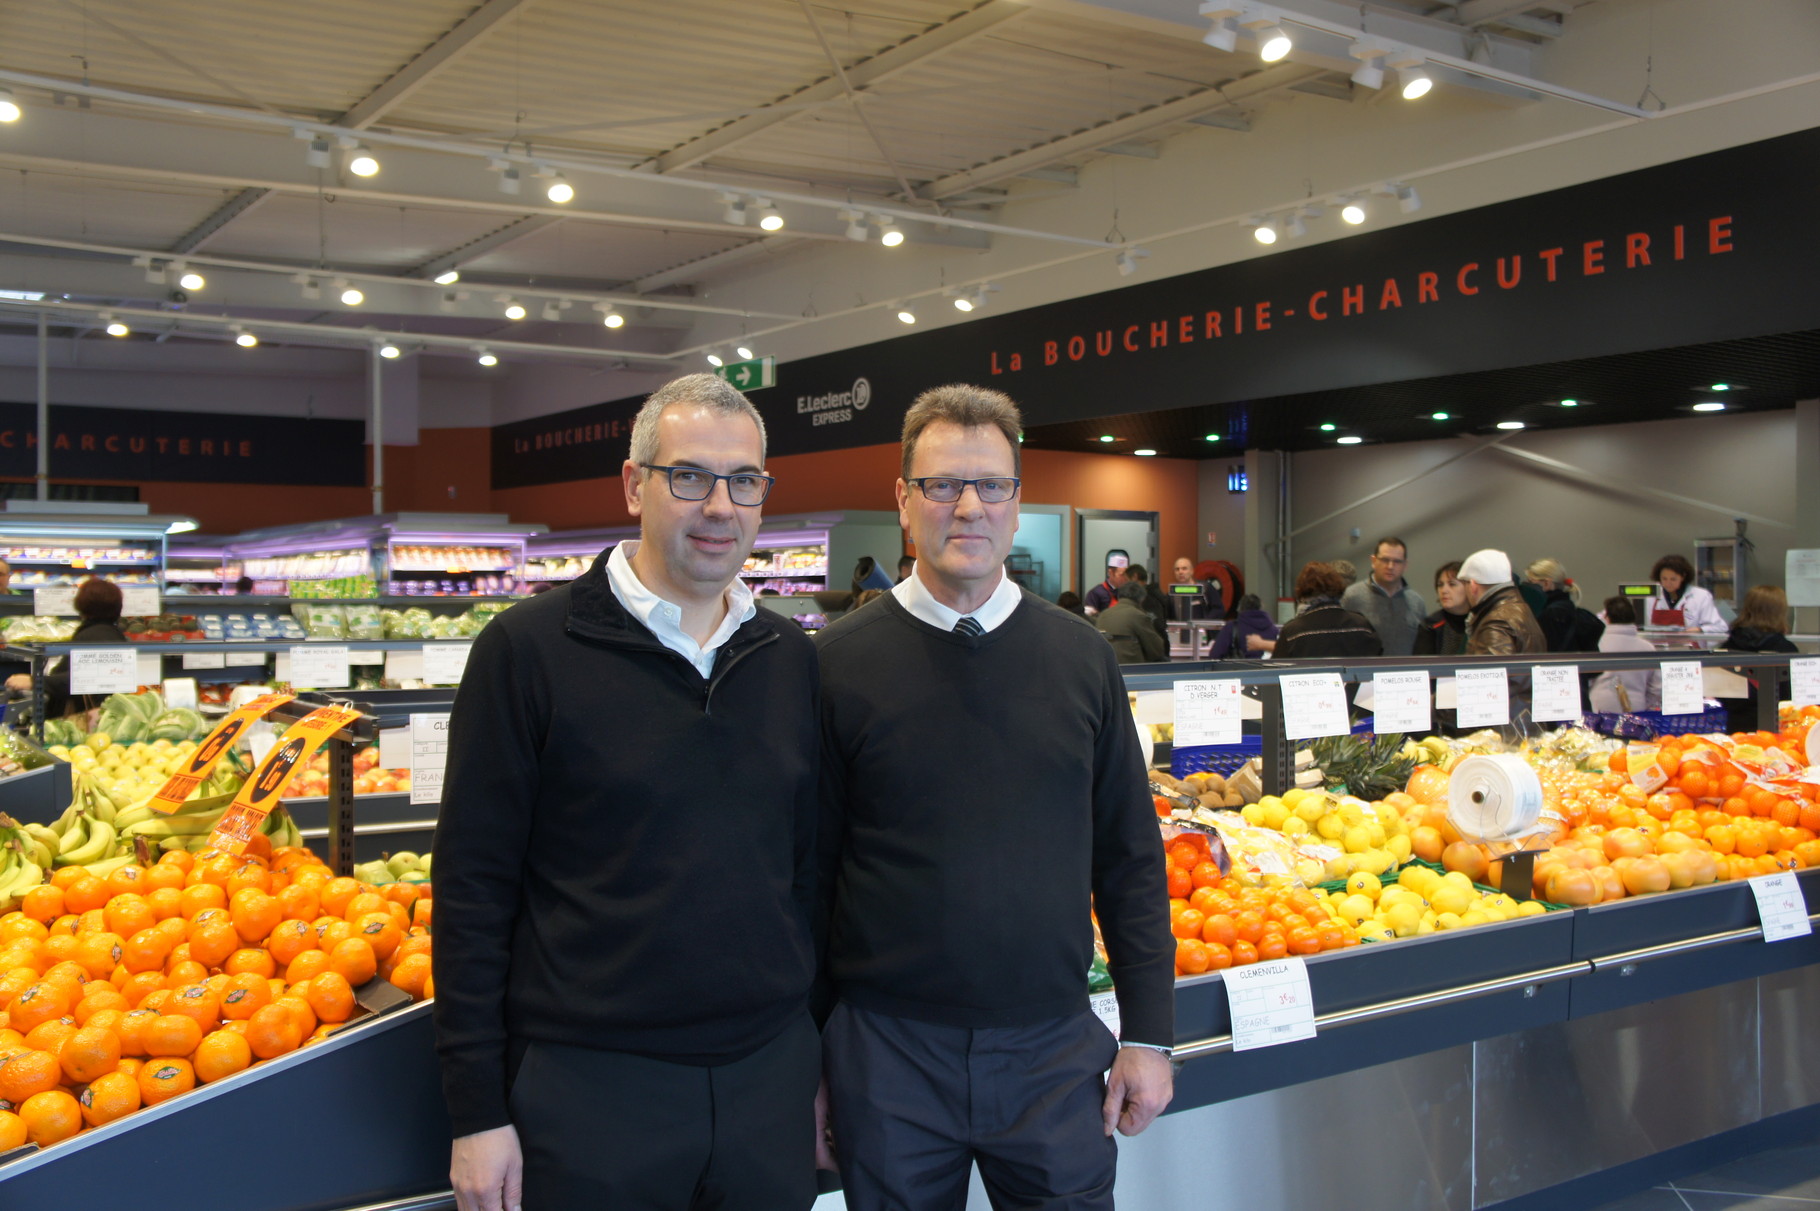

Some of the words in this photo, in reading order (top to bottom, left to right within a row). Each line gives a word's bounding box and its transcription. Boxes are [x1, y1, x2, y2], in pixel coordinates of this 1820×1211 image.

[991, 350, 1022, 375] La
[1044, 215, 1734, 367] BOUCHERIE-CHARCUTERIE
[797, 391, 852, 414] E.Leclerc
[812, 408, 852, 427] EXPRESS
[514, 438, 529, 454] La
[1184, 684, 1207, 692] CITRON
[1289, 680, 1310, 688] CITRON
[1380, 677, 1404, 685] POMELOS
[1196, 691, 1218, 700] VERGER
[1239, 965, 1289, 980] CLEMENVILLA
